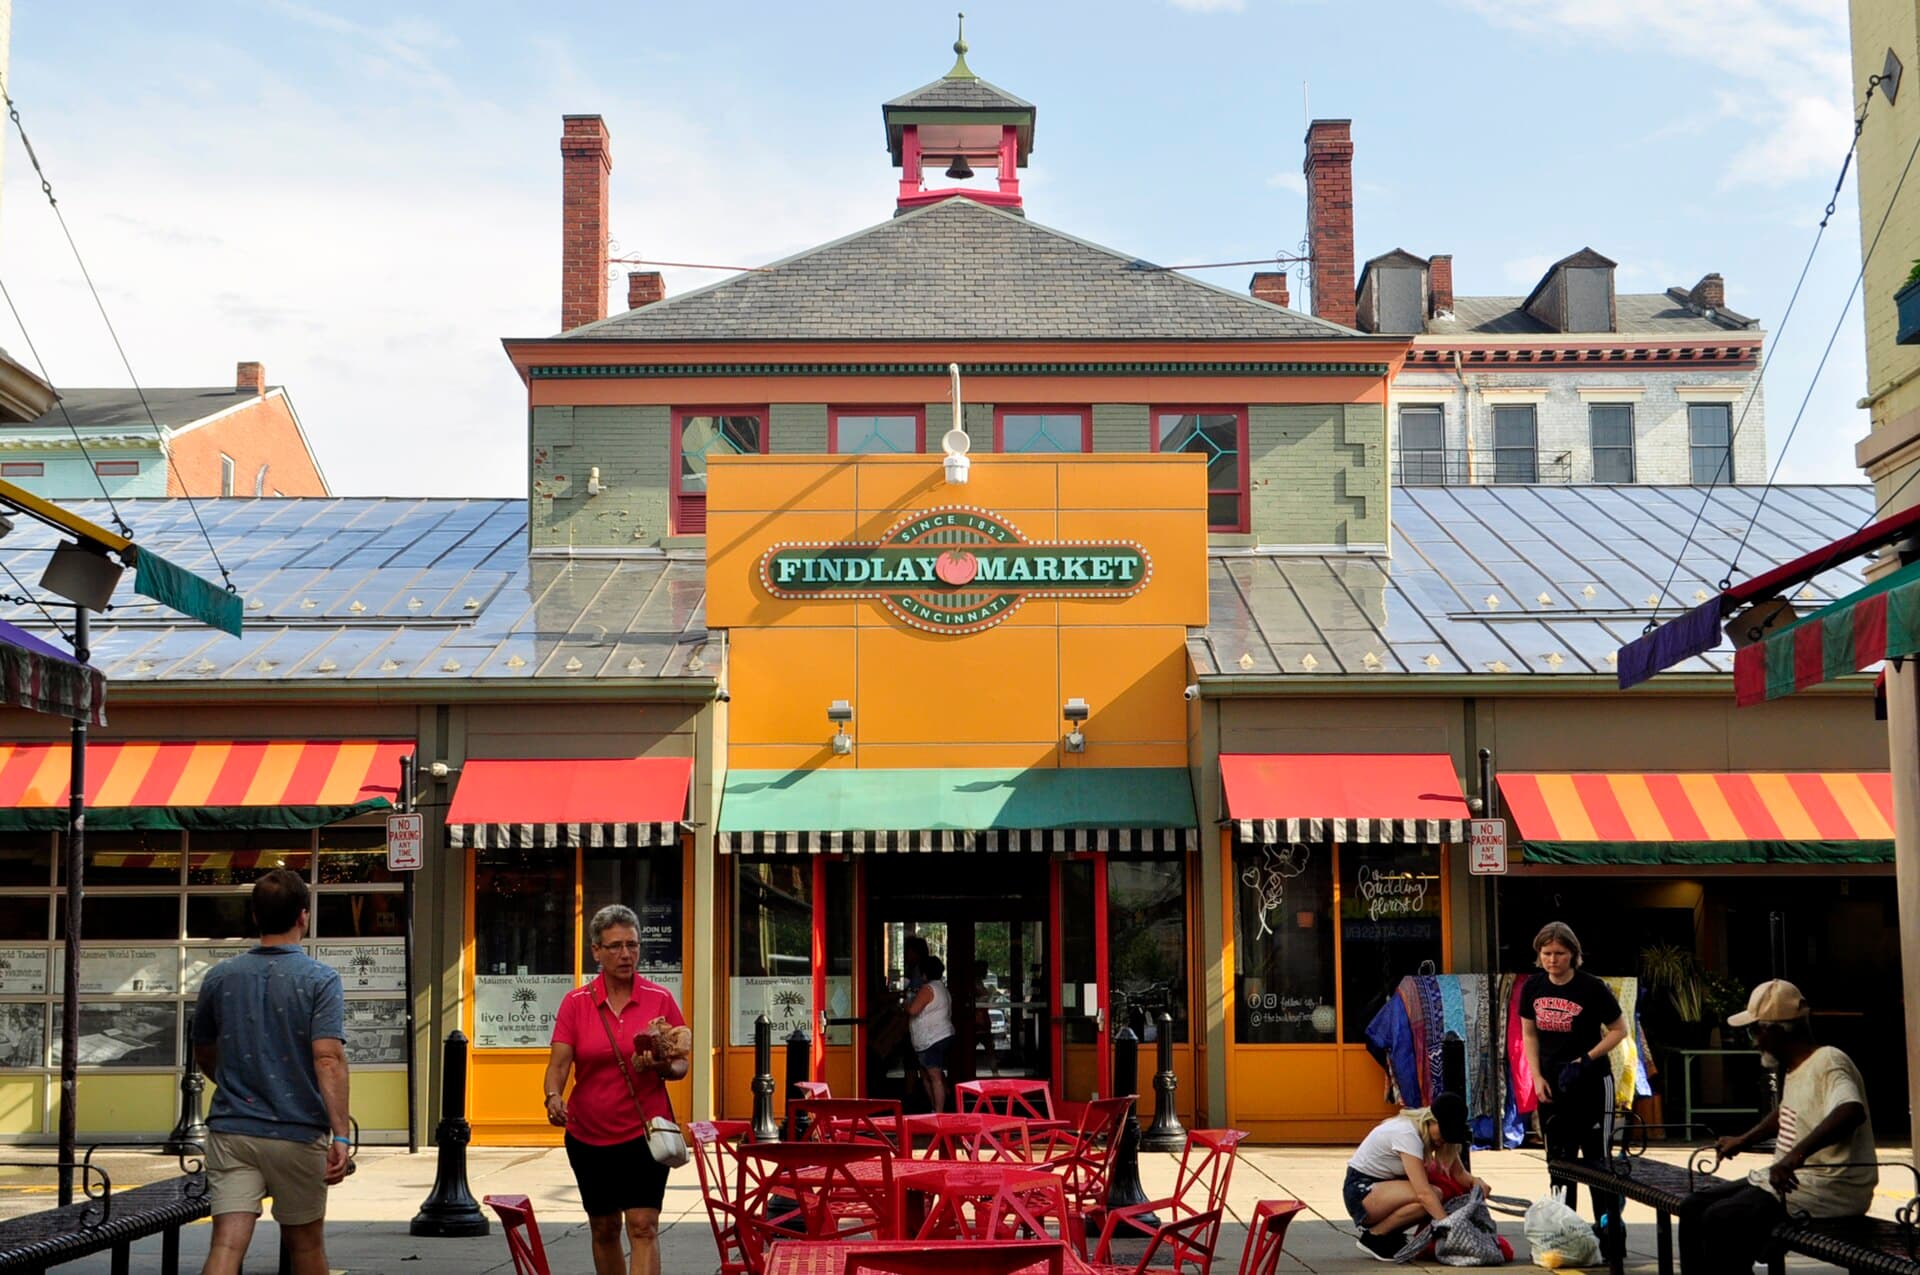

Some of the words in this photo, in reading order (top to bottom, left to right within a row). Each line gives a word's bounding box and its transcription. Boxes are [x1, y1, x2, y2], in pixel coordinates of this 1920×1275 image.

[901, 514, 956, 542] SINCE
[968, 516, 1006, 541] 1852
[776, 556, 938, 583] FINDLAY
[974, 555, 1138, 582] MARKET
[902, 596, 1007, 624] CINCINNATI
[397, 819, 410, 830] NO
[1480, 824, 1494, 835] NO
[388, 831, 419, 841] PARKING
[1471, 835, 1504, 845] PARKING
[398, 849, 412, 857] TIME
[1481, 853, 1496, 861] TIME
[17, 950, 46, 959] Traders
[107, 950, 130, 958] World
[130, 950, 157, 958] Traders
[319, 948, 353, 956] Maumee
[355, 947, 379, 956] World
[381, 947, 405, 956] Trade
[478, 976, 513, 985] Maumee
[514, 976, 540, 984] World
[542, 976, 573, 984] Traders
[650, 975, 679, 983] Traders
[1533, 997, 1583, 1016] CINCINNATI
[480, 1012, 504, 1023] live
[508, 1012, 536, 1023] love
[539, 1011, 558, 1024] giv
[770, 1020, 789, 1031] eat
